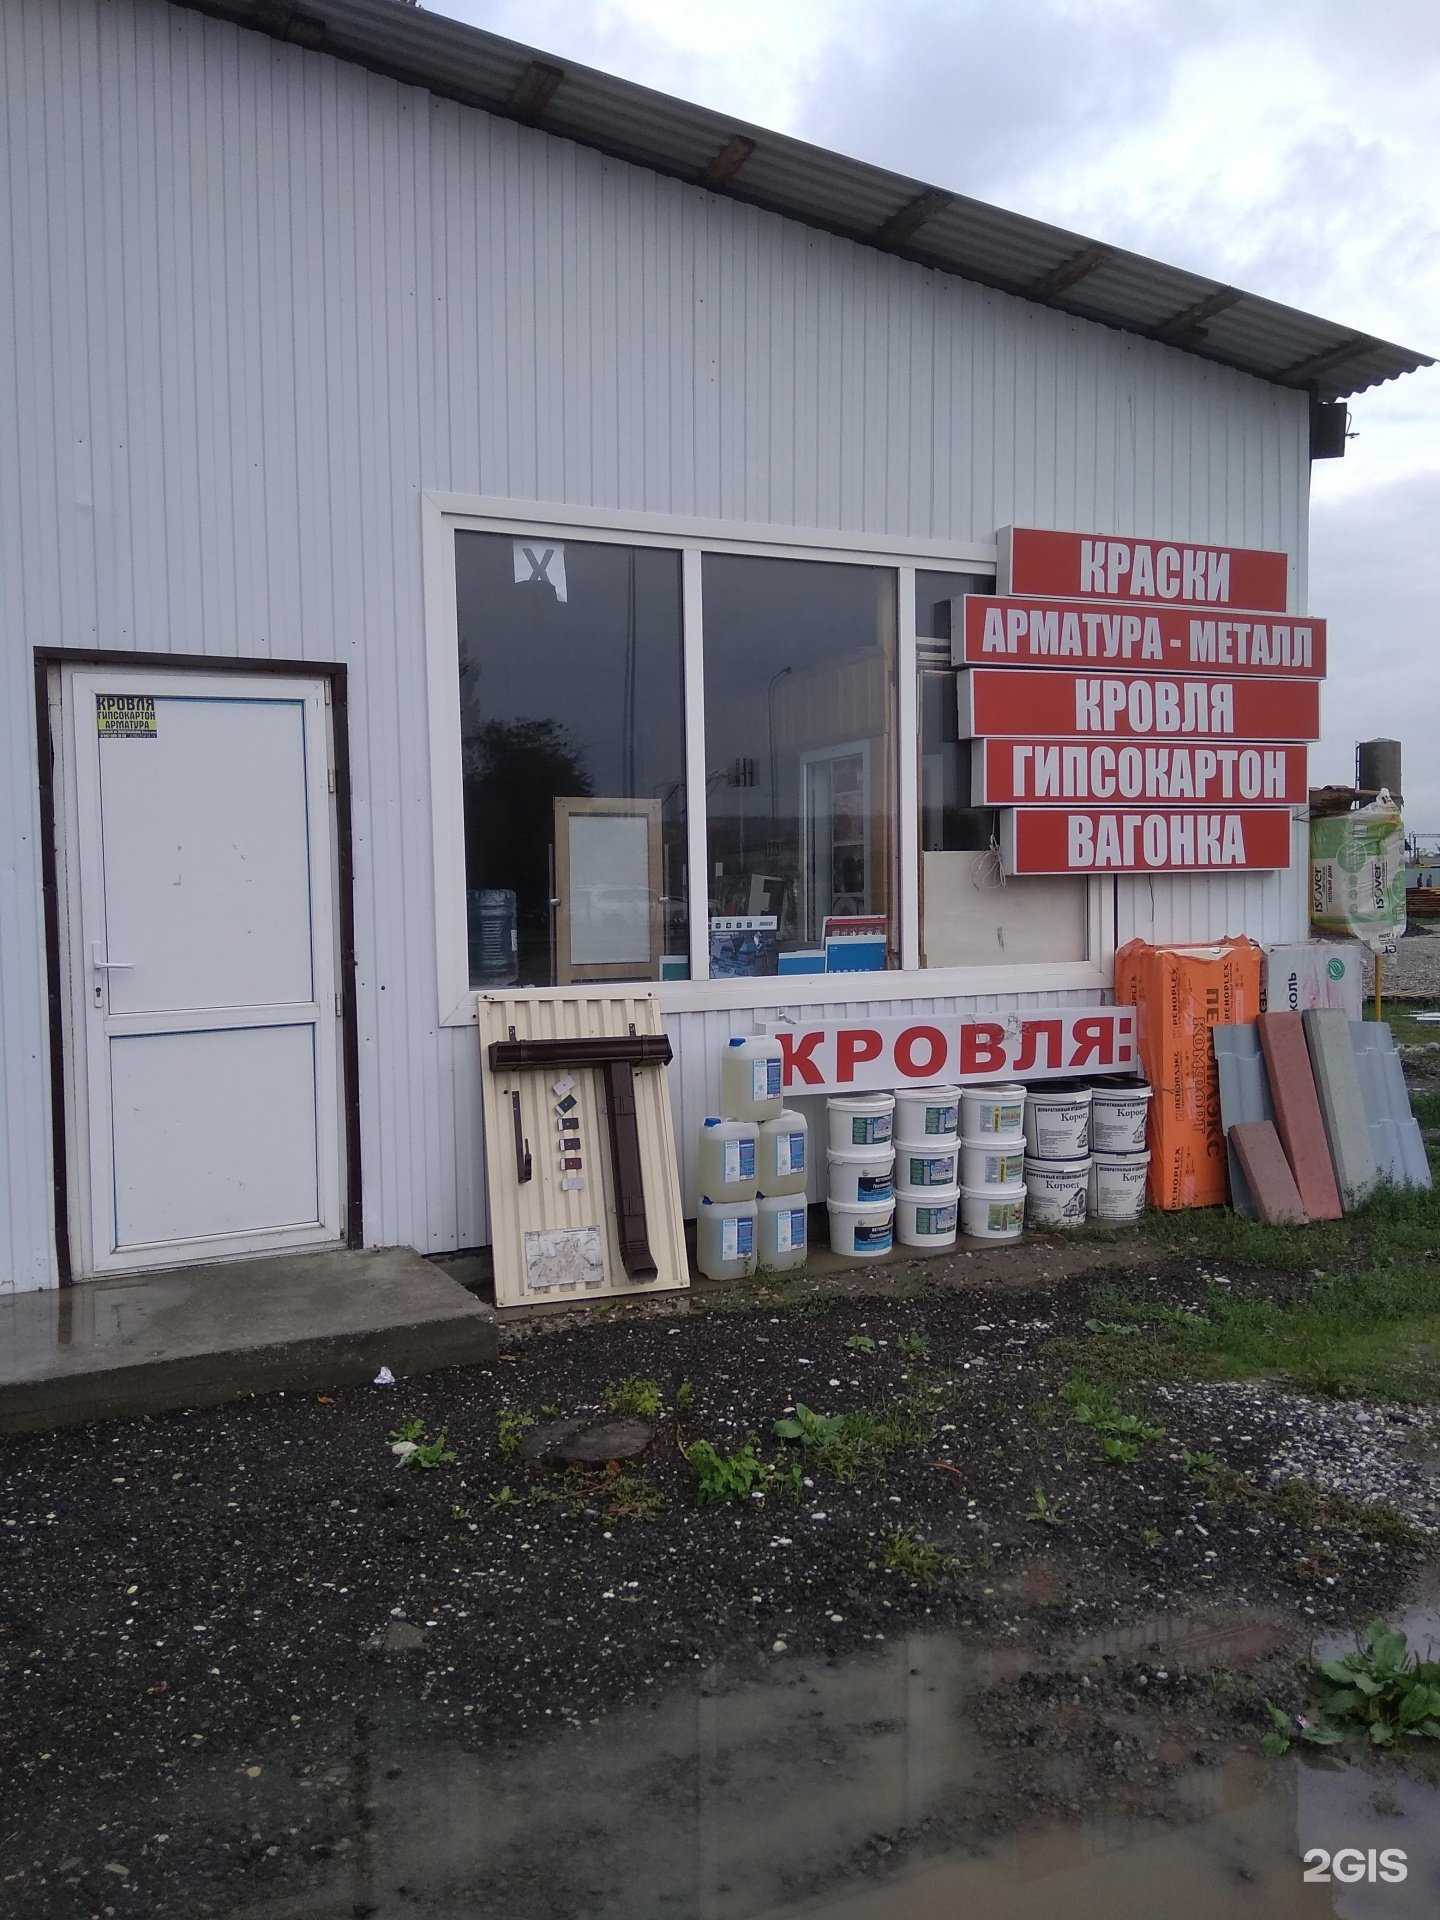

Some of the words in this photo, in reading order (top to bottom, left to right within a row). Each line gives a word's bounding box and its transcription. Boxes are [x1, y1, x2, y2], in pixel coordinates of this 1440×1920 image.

[1080, 539, 1231, 602] КРАСКИ
[982, 607, 1163, 660] АРМАТУРА
[1189, 620, 1313, 668] МЕТАЛЛ
[97, 697, 155, 711] КРОВЛЯ
[97, 711, 156, 720] ГИПСОКАРТОН
[105, 720, 150, 729] АРМАТУРА
[1075, 679, 1234, 733] КРОВЛЯ
[1012, 745, 1286, 799] ГИПСОКАРТОН
[1067, 814, 1246, 867] ВАГОНКА
[775, 1016, 1132, 1087] КРОВЛЯ:
